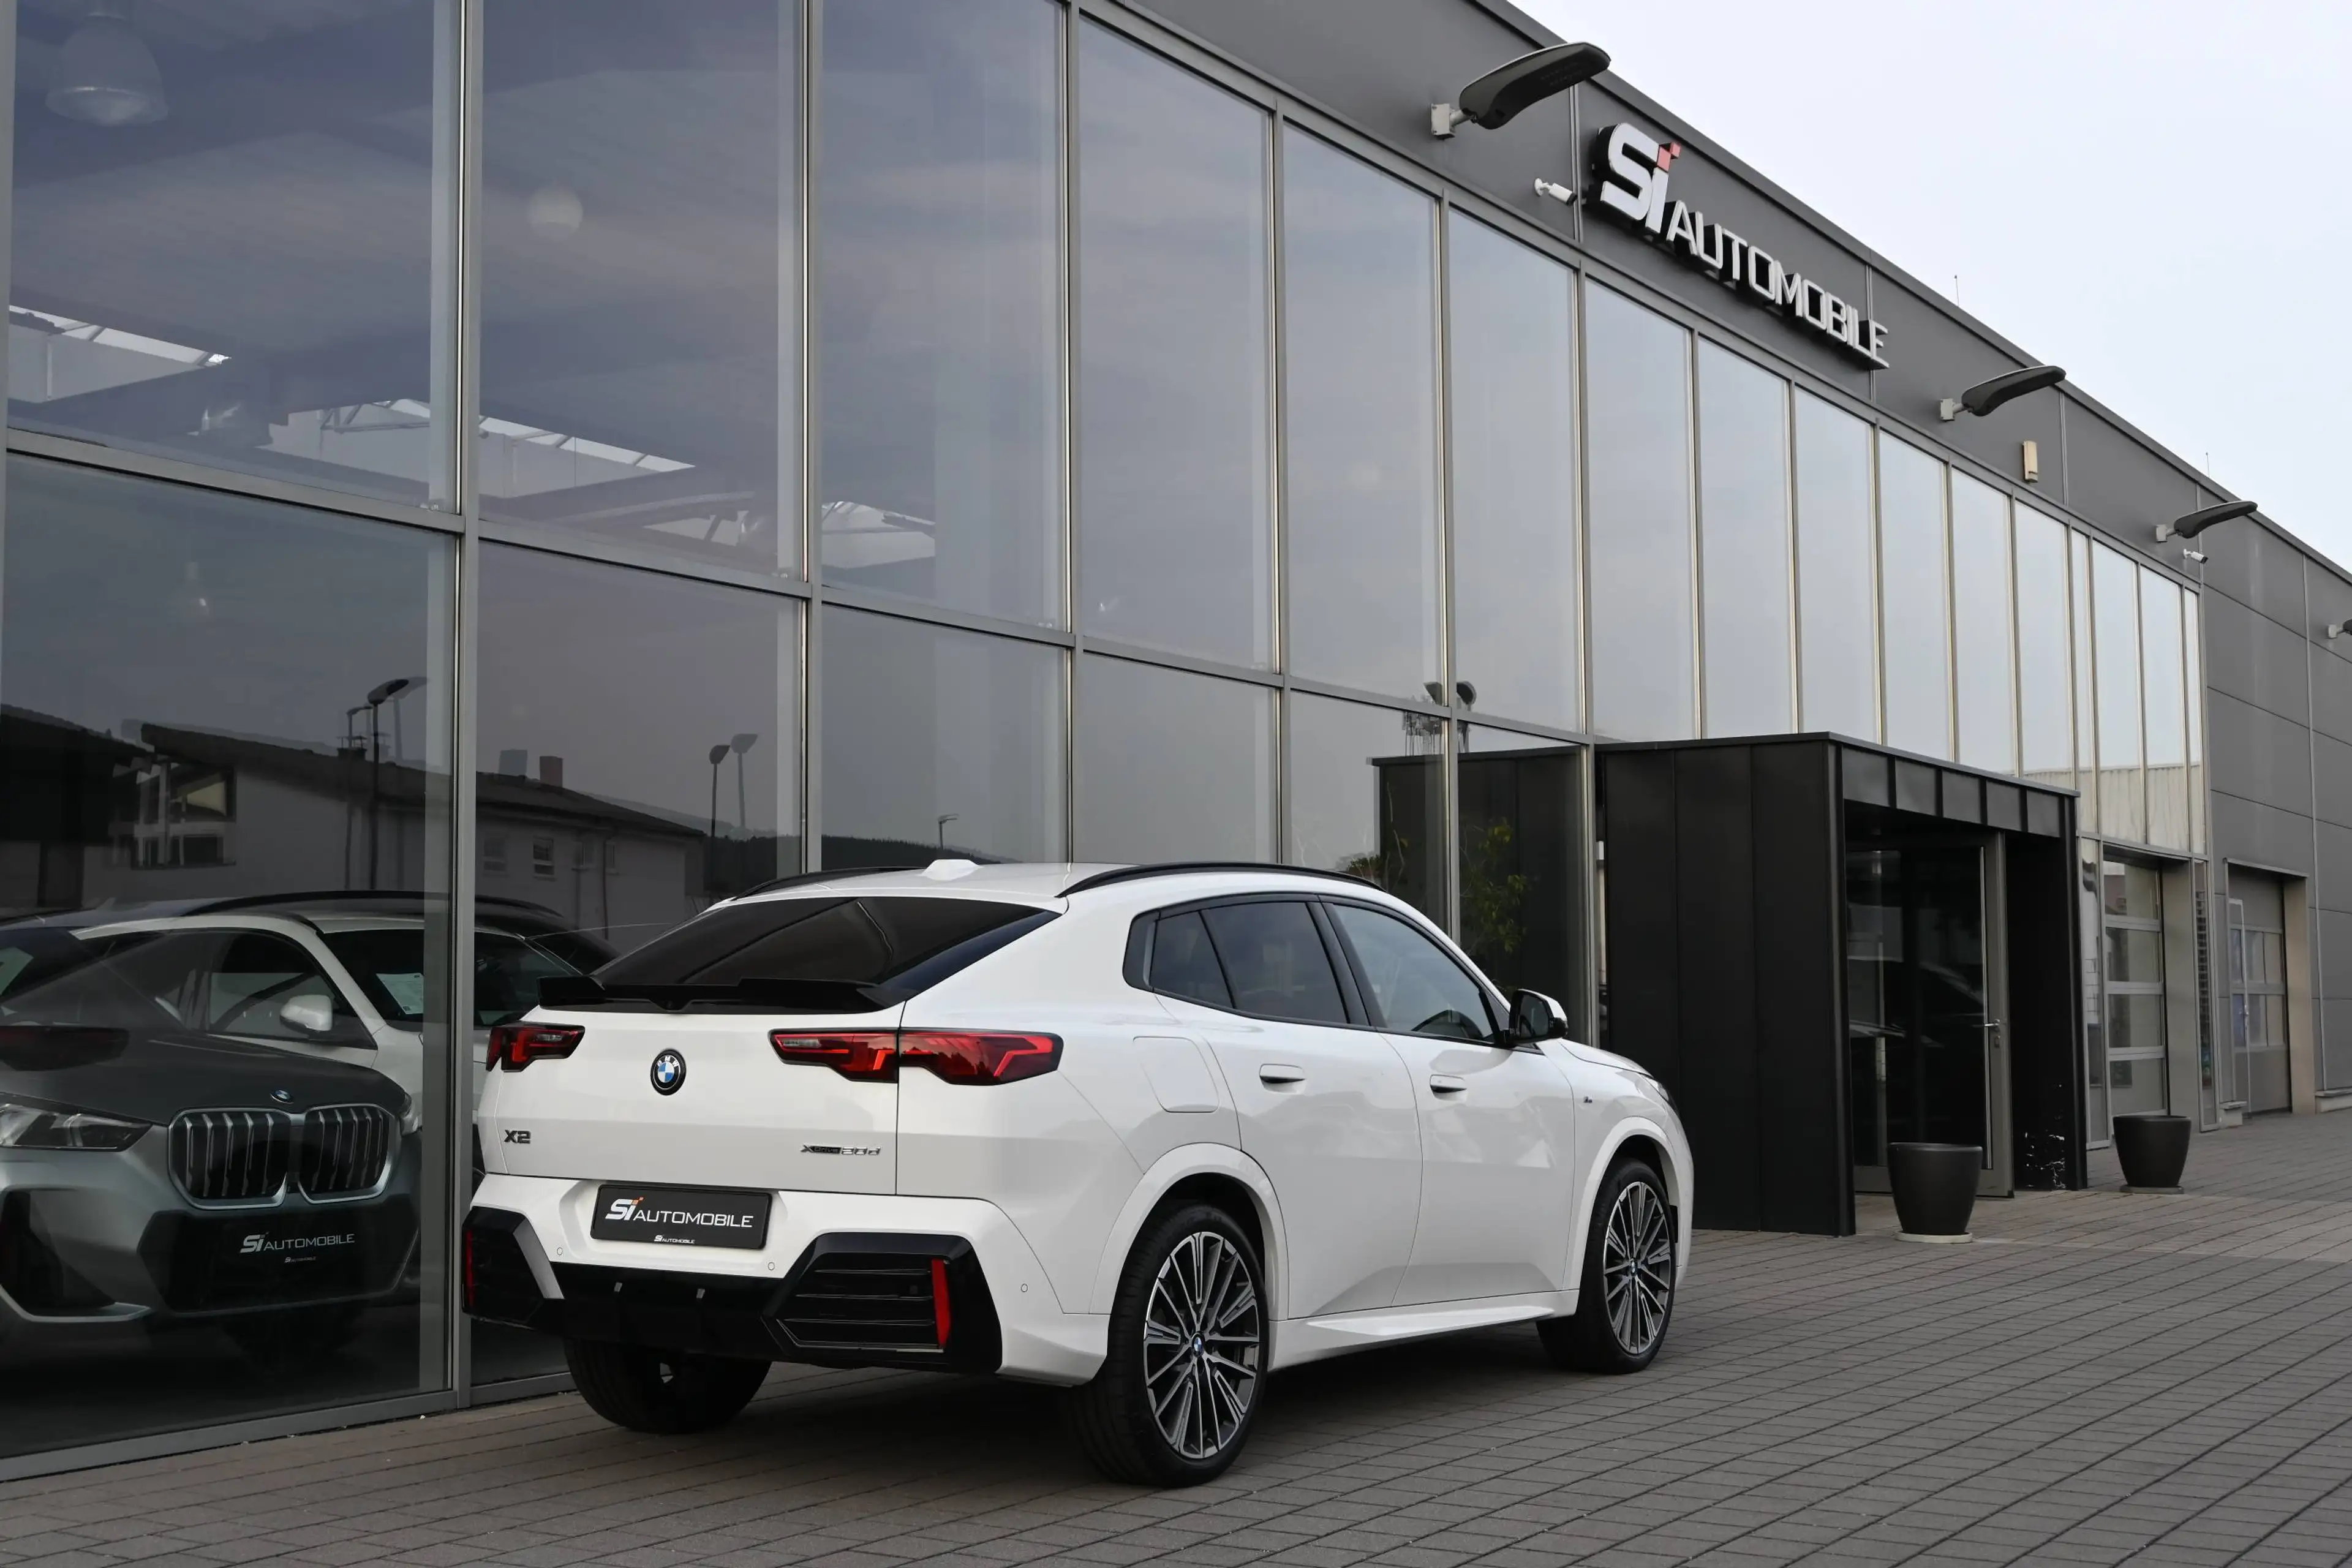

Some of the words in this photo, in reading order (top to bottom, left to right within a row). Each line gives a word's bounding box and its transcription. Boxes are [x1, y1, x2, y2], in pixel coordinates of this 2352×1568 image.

[1665, 199, 1890, 369] AUTOMOBILE
[657, 1055, 679, 1068] BMW
[504, 1129, 531, 1144] X2
[633, 1210, 753, 1228] AUTOMOBILE
[263, 1233, 355, 1251] AUTOMOBILE
